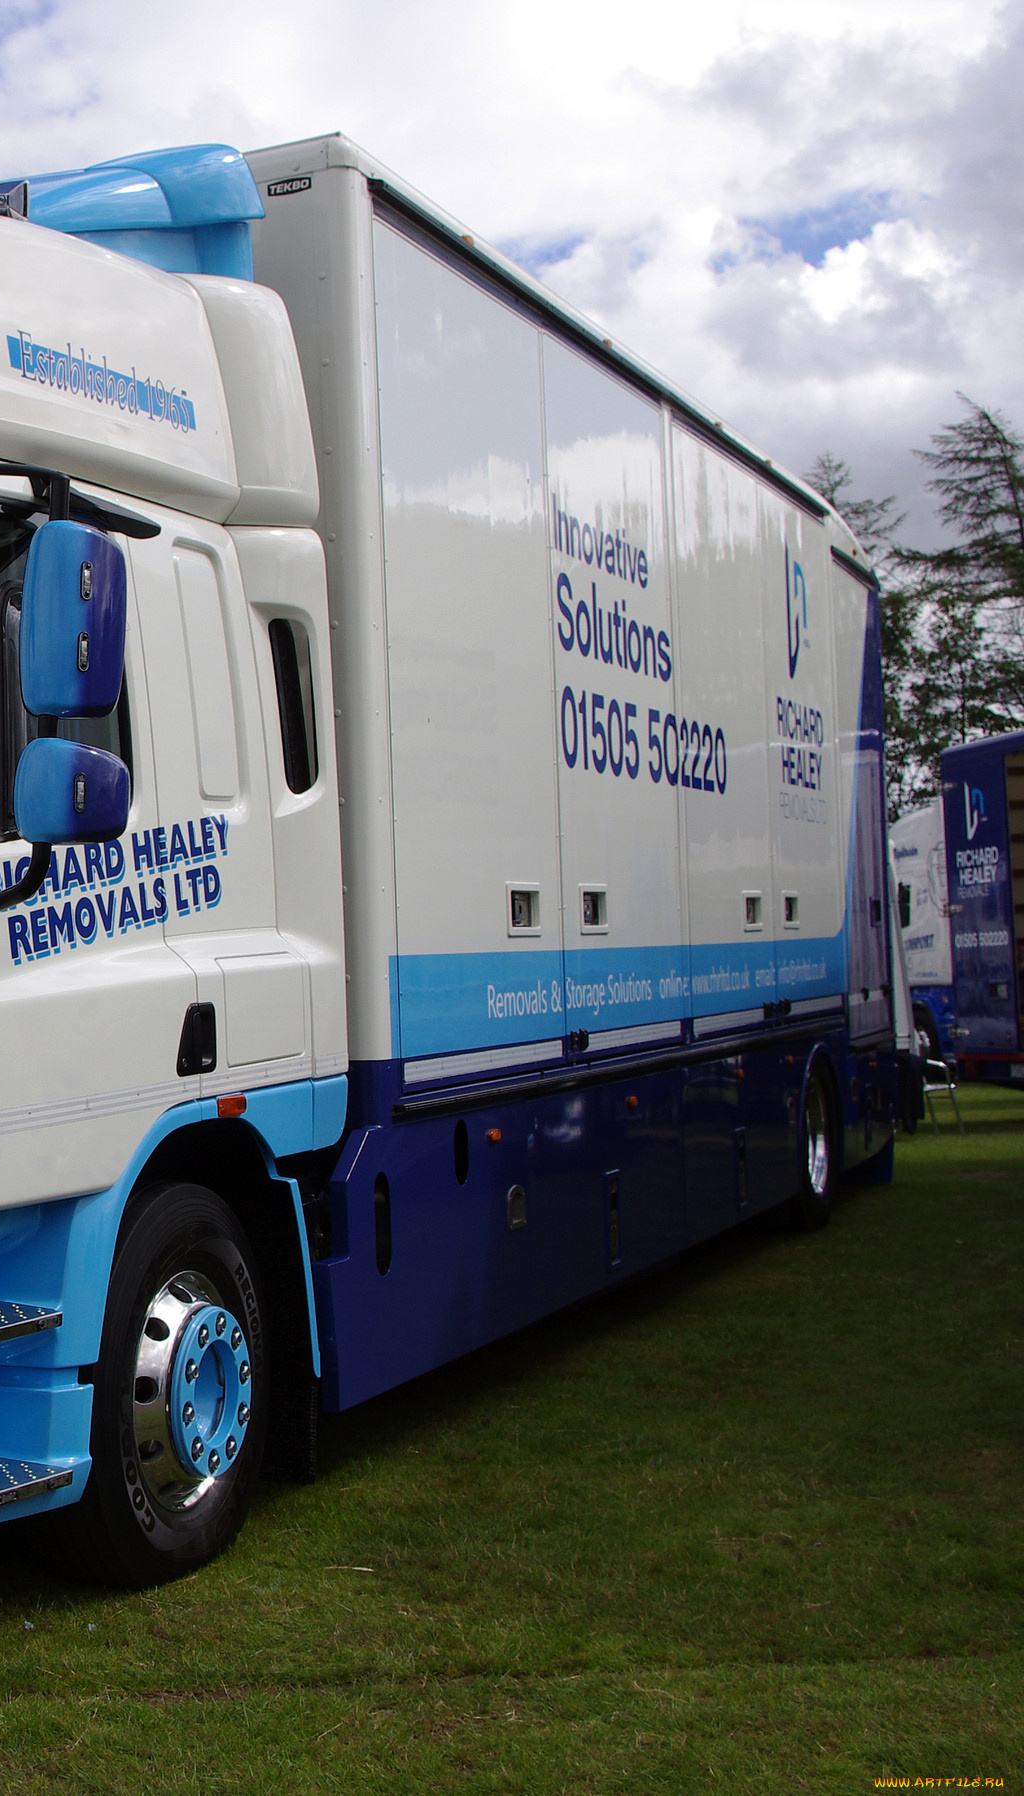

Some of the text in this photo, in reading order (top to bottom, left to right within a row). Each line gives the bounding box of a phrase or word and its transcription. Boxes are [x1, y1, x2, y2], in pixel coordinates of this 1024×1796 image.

[269, 178, 311, 195] TEKBO
[17, 329, 139, 415] Established
[551, 492, 649, 589] Innovative
[557, 572, 672, 682] Solutions
[561, 686, 727, 795] 01505 502220
[776, 695, 824, 748] RICHARD
[781, 744, 822, 792] HEALEY
[131, 813, 230, 877] HEALEY
[956, 846, 999, 868] RICHARD
[959, 866, 997, 886] HEALEY
[7, 864, 223, 965] REMOVALS LTD
[487, 979, 547, 1019] Removals
[551, 980, 562, 1012] &
[566, 976, 605, 1016] Storage
[607, 971, 652, 1005] Solutions
